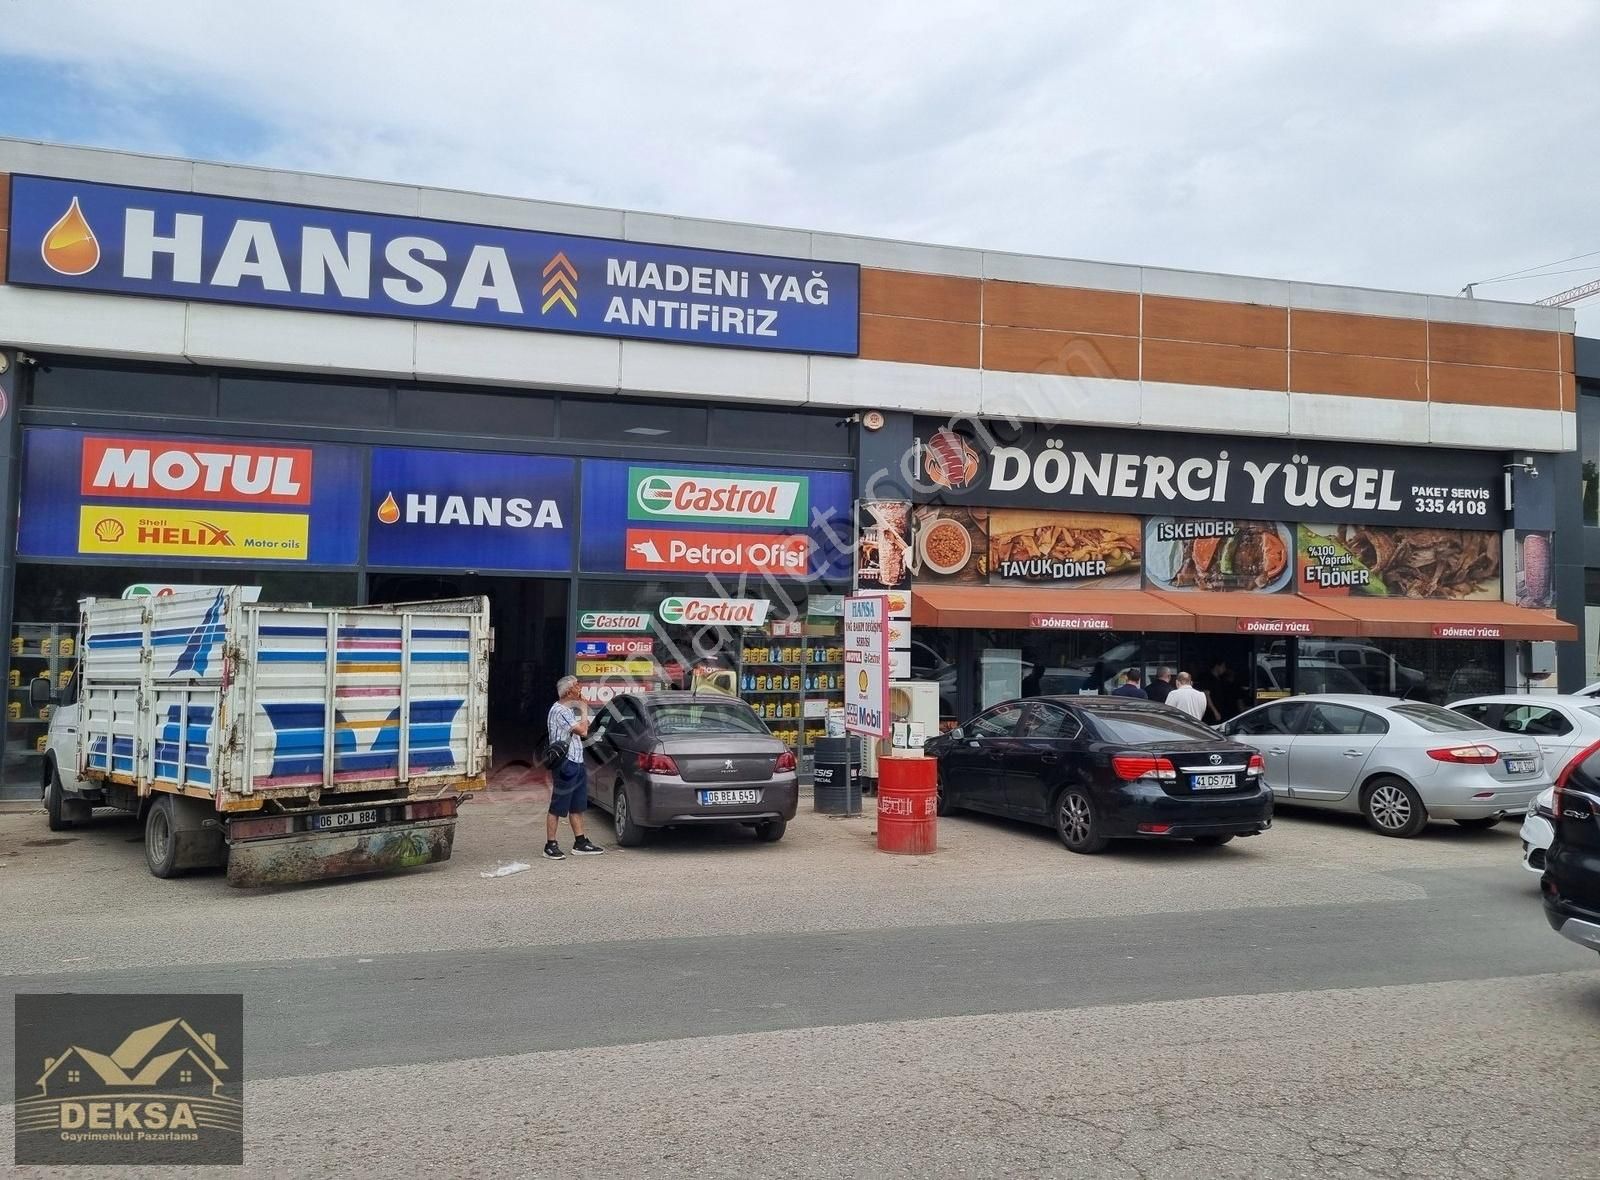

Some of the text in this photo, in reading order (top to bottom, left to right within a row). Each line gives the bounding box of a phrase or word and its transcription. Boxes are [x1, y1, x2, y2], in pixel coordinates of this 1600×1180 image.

[122, 207, 524, 315] HANSA
[760, 270, 829, 305] YAĞ
[92, 447, 301, 496] MOTUL
[988, 438, 1402, 511] DÖNERCİ YÜCEL
[674, 481, 778, 514] Castrol
[1411, 486, 1448, 498] PAKET
[405, 493, 564, 529] HANSA
[1415, 498, 1444, 513] 335
[138, 518, 167, 527] Shell
[138, 526, 236, 547] HELIX
[244, 538, 300, 549] Motor oils
[670, 540, 805, 568] Petrol Ofisi
[1308, 545, 1335, 556] %100
[1319, 553, 1352, 567] Yaprak
[1001, 559, 1107, 579] TAVUK DÖNER
[1306, 565, 1369, 587] ET DÖNER
[685, 600, 755, 622] Castrol
[852, 601, 875, 618] HANSA
[596, 615, 641, 628] Castrol
[1083, 618, 1110, 628] YÜCEL
[627, 641, 652, 653] Ofisi
[859, 706, 880, 729] Mobil
[1196, 775, 1234, 786] 41 DS 771
[708, 791, 719, 801] 06
[721, 791, 737, 801] BEA
[320, 810, 376, 827] 06 CPJ 884
